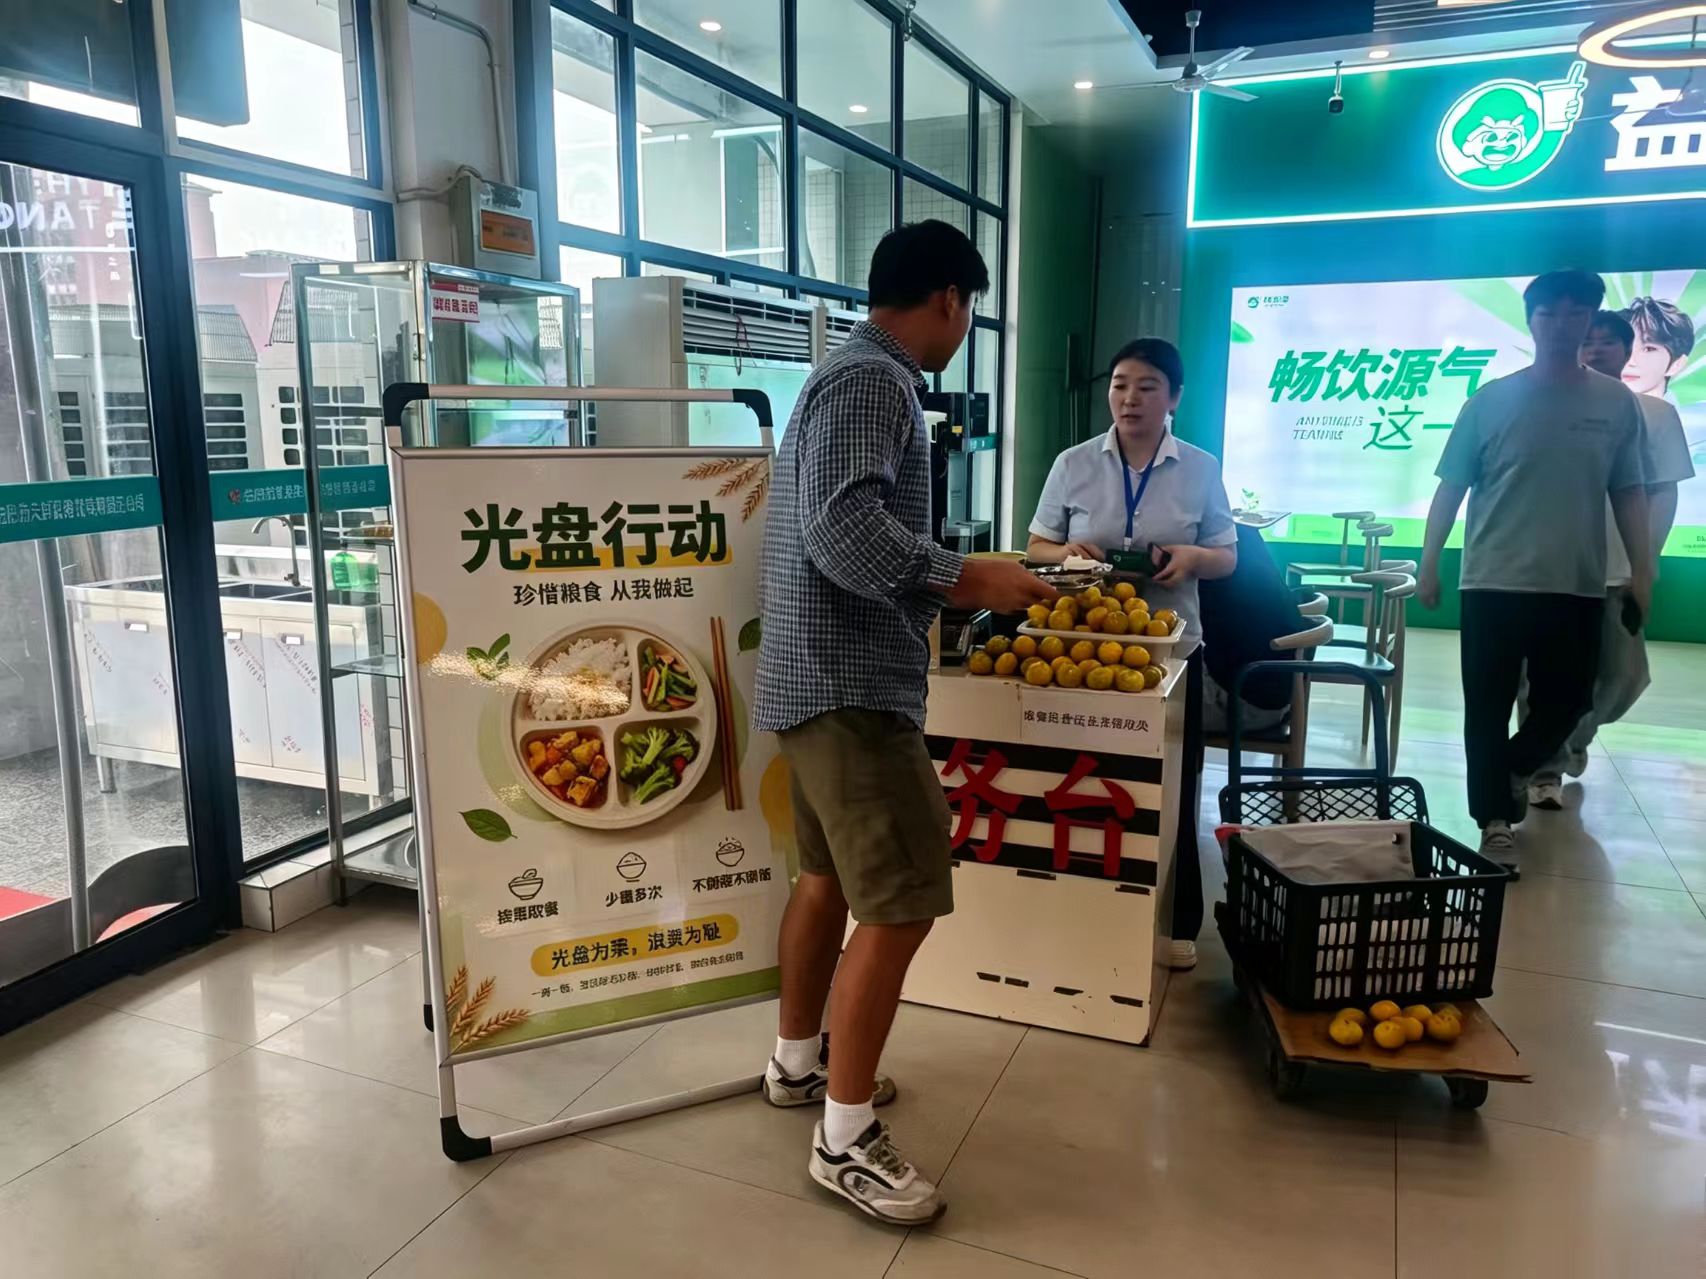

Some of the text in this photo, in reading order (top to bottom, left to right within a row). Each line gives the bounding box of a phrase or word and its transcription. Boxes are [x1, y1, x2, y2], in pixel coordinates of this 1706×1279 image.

[1268, 345, 1498, 404] 畅饮源气
[461, 500, 726, 573] 光盘行动
[513, 577, 695, 607] 珍惜粮食 从我做起
[605, 885, 663, 907] 少量多次
